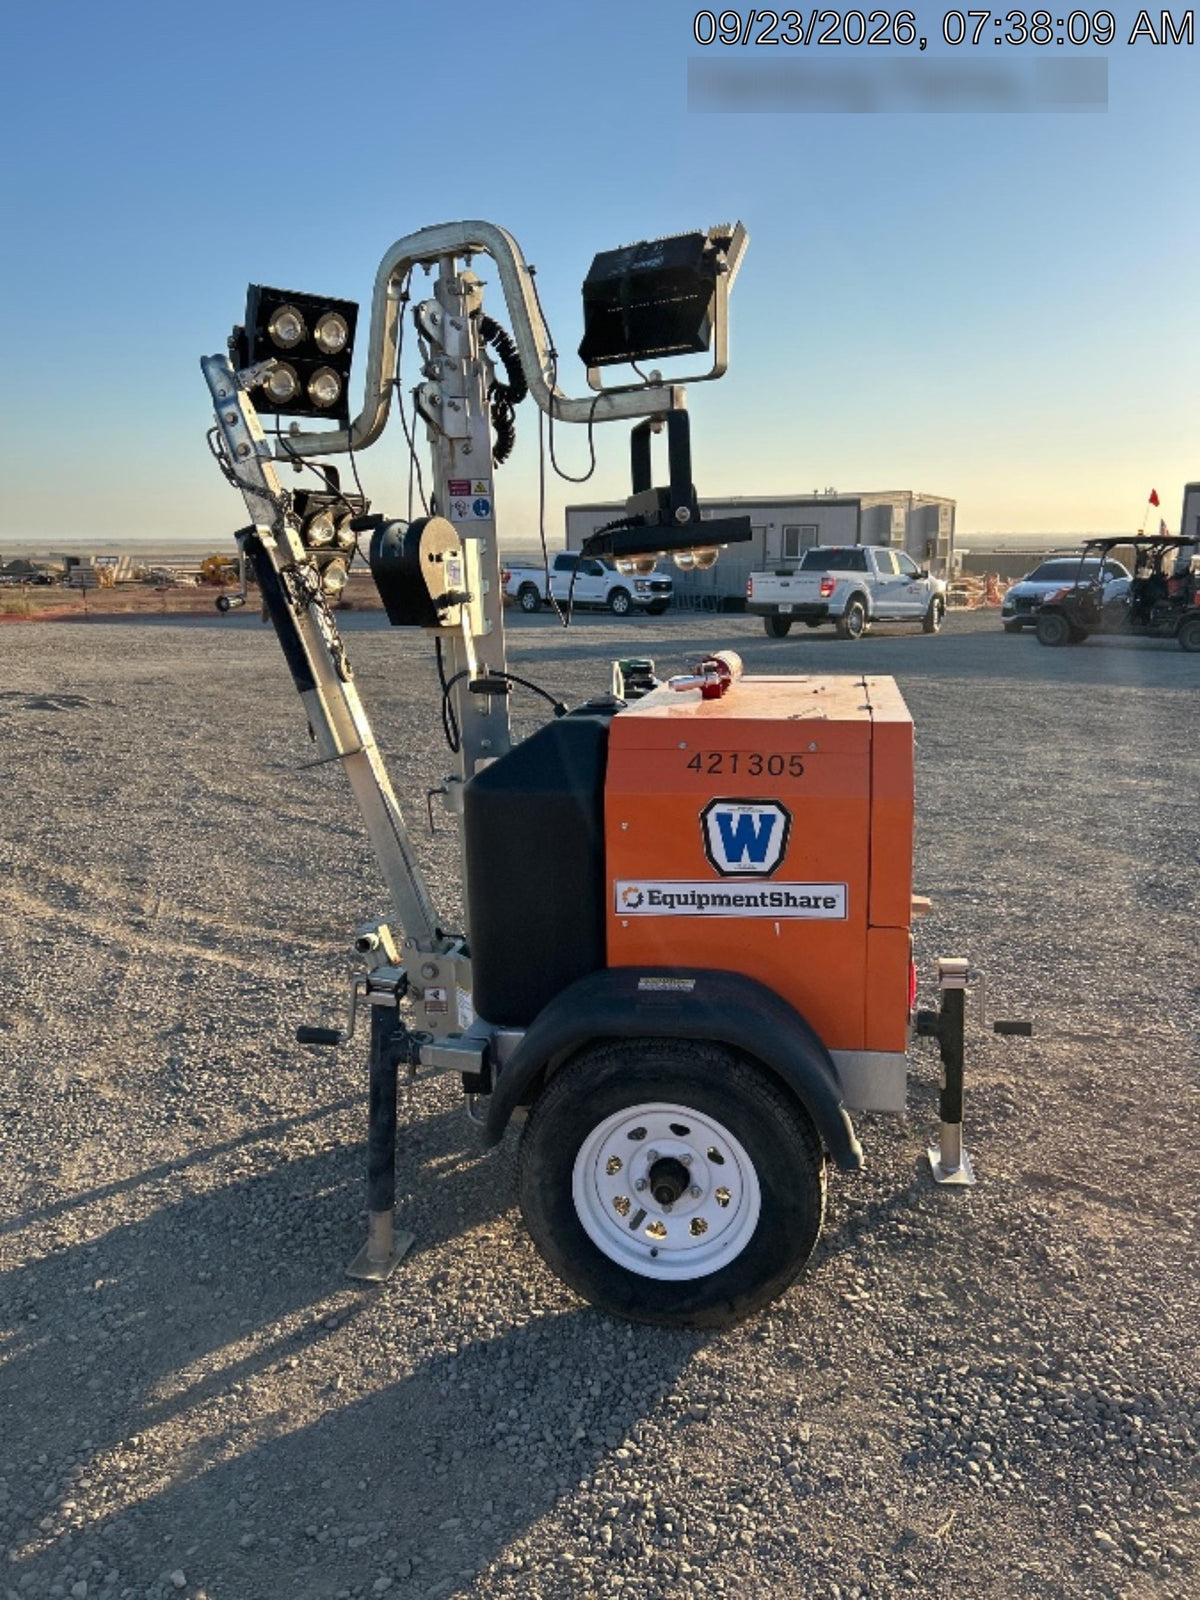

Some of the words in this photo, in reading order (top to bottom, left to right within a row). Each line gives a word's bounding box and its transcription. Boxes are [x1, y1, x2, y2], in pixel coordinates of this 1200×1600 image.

[686, 752, 804, 777] 421305
[715, 812, 776, 863] W
[647, 889, 837, 909] EquipmentShare
